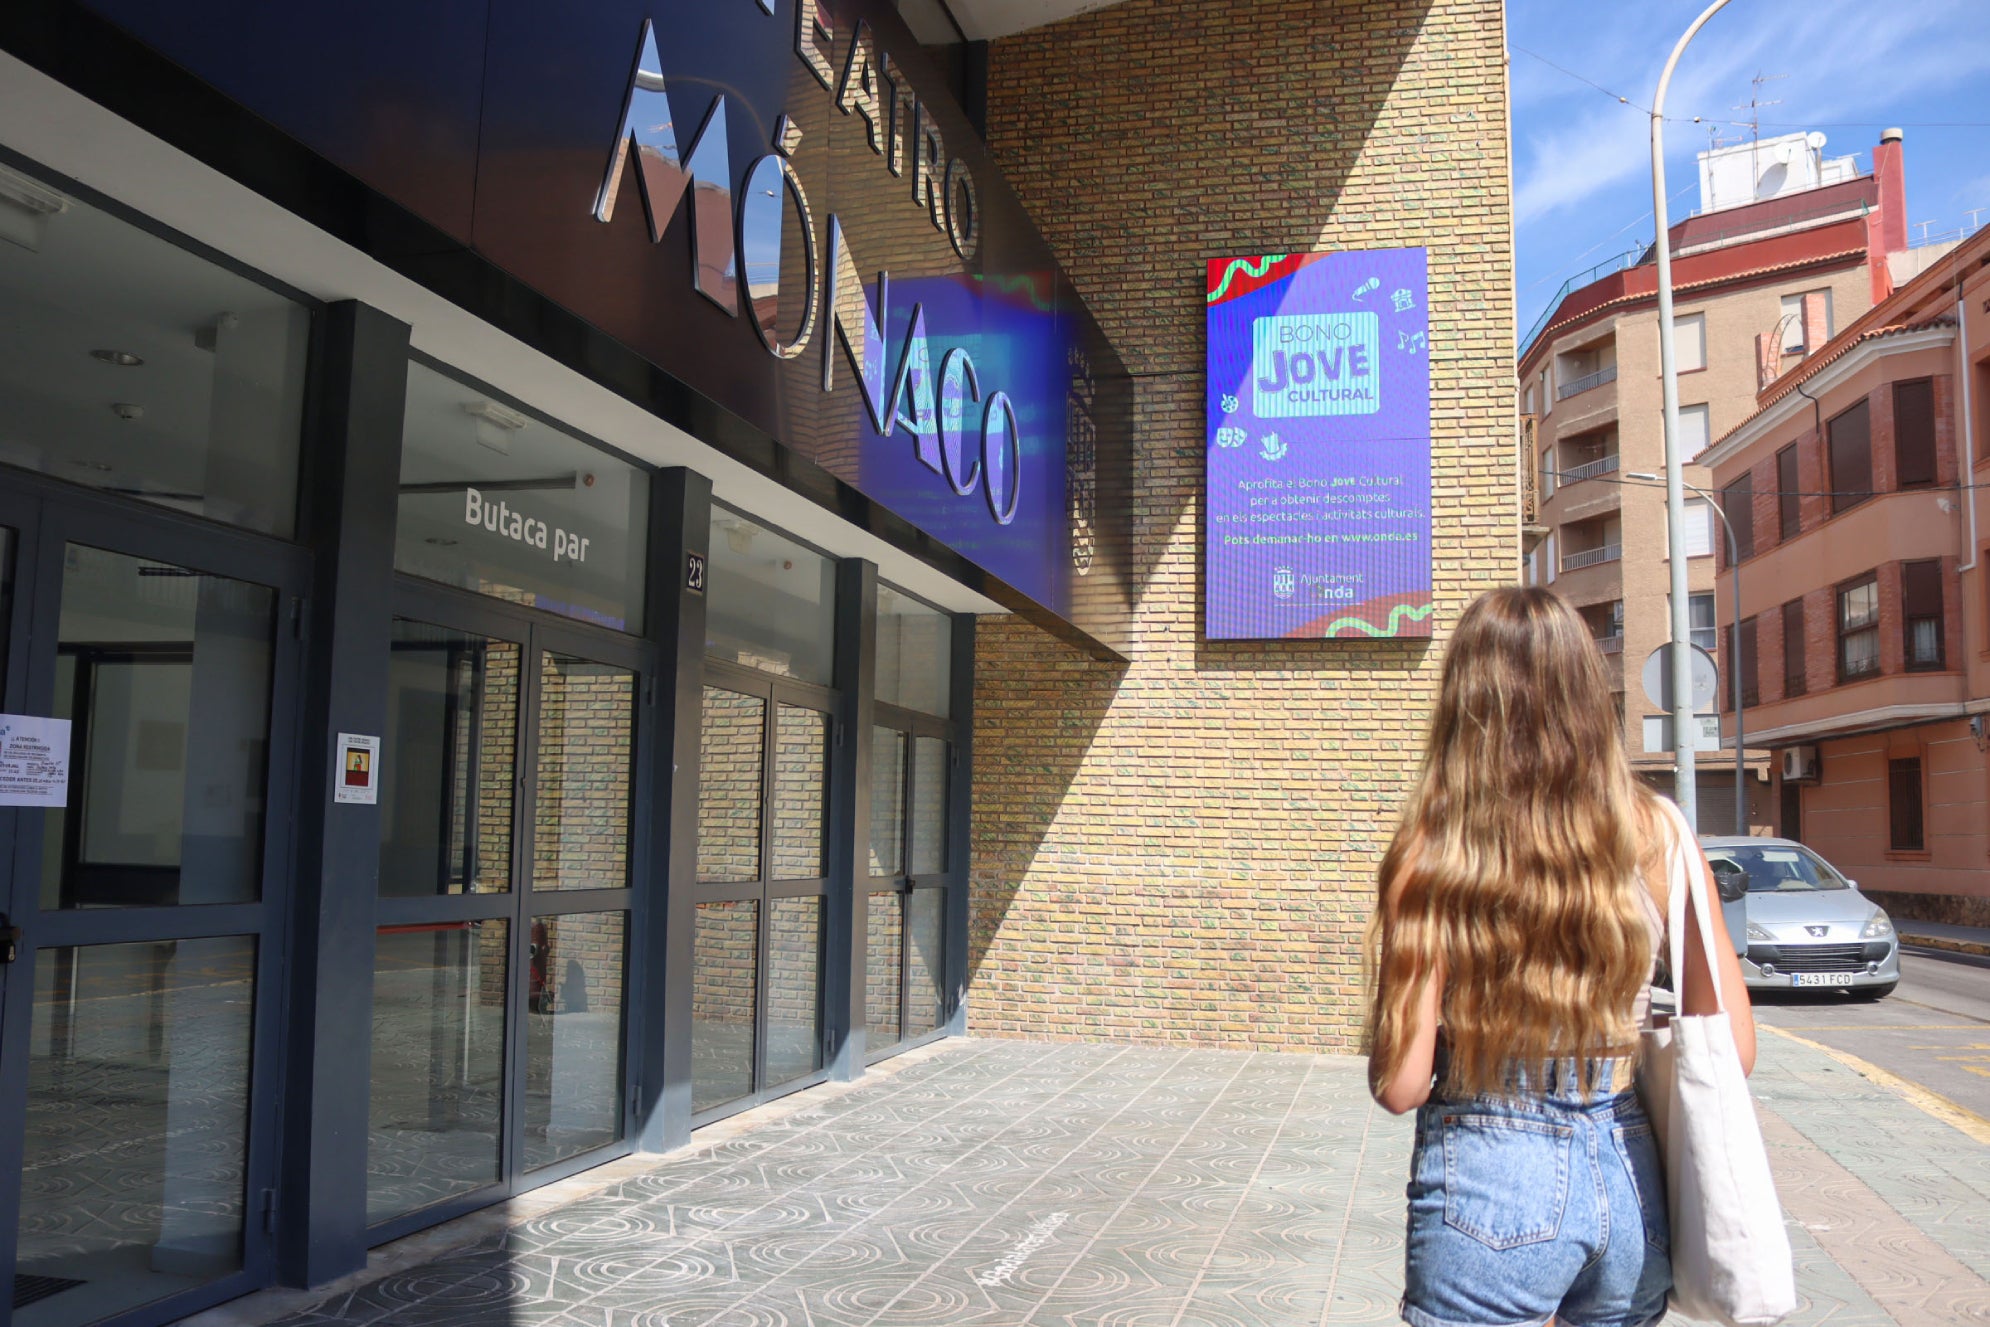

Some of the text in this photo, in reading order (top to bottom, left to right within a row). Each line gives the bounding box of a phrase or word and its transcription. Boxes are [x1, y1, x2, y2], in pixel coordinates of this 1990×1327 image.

[755, 0, 978, 260] EATRO
[592, 18, 1020, 526] MÓNACO
[1280, 322, 1352, 343] BONO
[1258, 344, 1370, 393] JOVE
[1288, 388, 1374, 403] CULTURAL
[1238, 478, 1283, 491] Aprofita
[1298, 477, 1328, 488] Bono
[1250, 492, 1391, 507] per a obtenir descomptes
[1216, 514, 1230, 523] en
[1250, 510, 1314, 523] espectacles
[465, 487, 590, 562] Butaca par
[1224, 535, 1250, 545] Pots
[1324, 533, 1339, 543] en
[1342, 532, 1419, 542] www.onda.es
[688, 557, 703, 589] 23
[1301, 573, 1364, 586] Ajuntament
[1800, 974, 1851, 985] 5431 FCD
